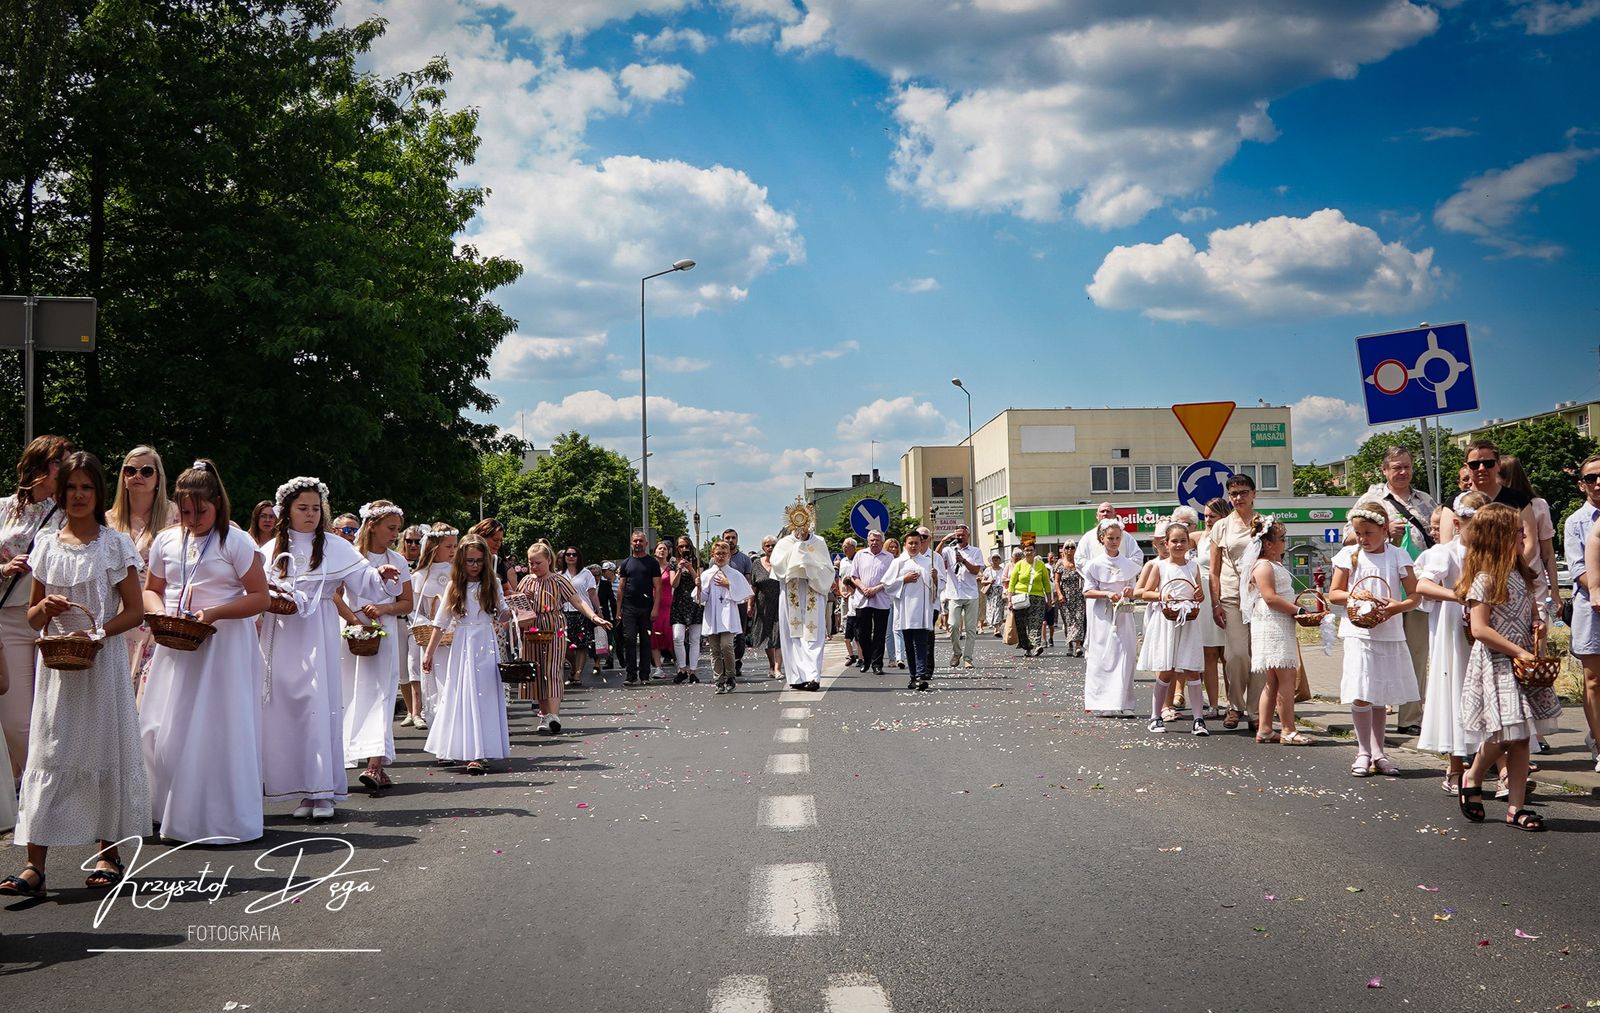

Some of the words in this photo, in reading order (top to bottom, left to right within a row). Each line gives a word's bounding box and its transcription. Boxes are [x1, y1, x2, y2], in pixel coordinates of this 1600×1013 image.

[1251, 423, 1281, 431] GABINET
[1255, 431, 1285, 440] MASAŻU
[1272, 511, 1298, 519] Apteka
[513, 596, 524, 610] WHO
[519, 594, 531, 611] SHOW
